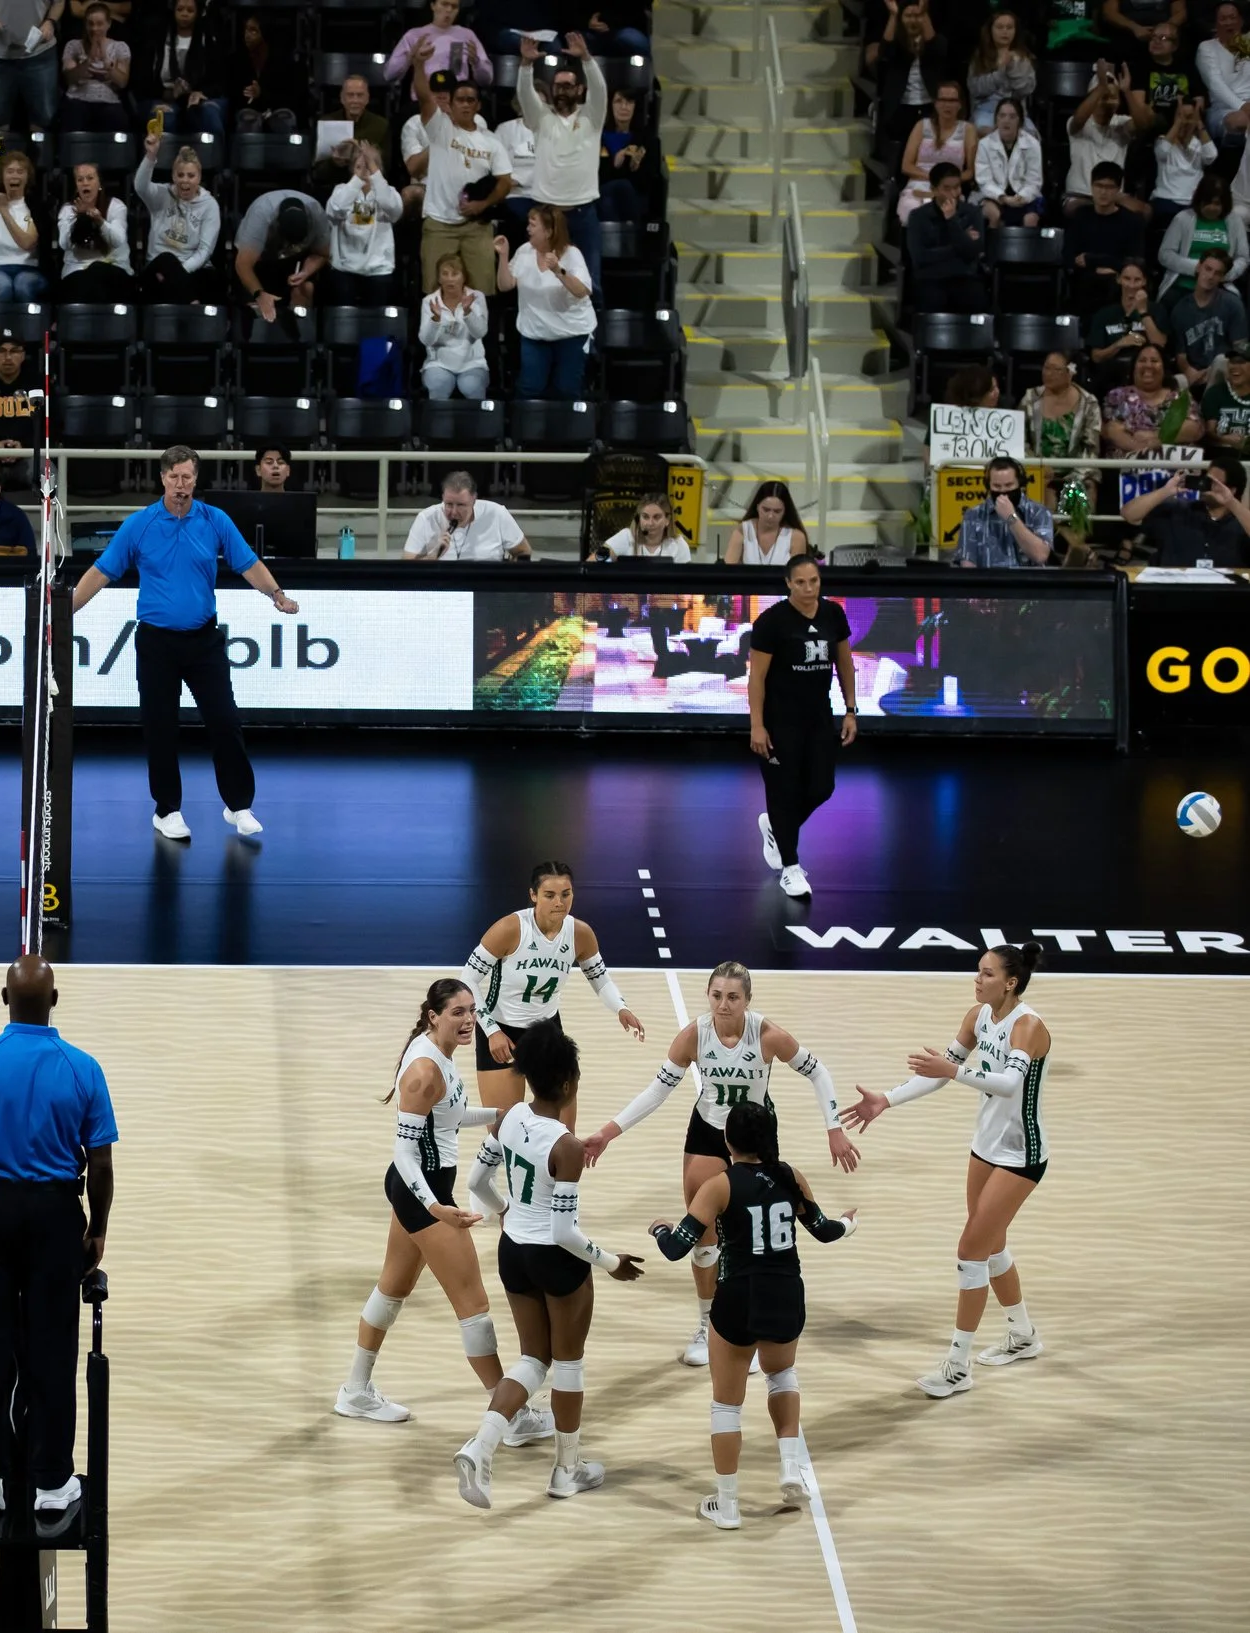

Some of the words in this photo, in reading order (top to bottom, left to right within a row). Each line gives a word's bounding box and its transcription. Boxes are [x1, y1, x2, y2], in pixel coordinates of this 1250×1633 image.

[986, 410, 1015, 440] GO
[670, 475, 694, 486] 103
[955, 491, 987, 501] ROW
[1146, 646, 1250, 695] GO
[785, 925, 1250, 955] WALTER
[522, 974, 559, 1004] 14
[712, 1082, 751, 1106] 10
[503, 1143, 536, 1205] 17
[746, 1200, 794, 1255] 16
